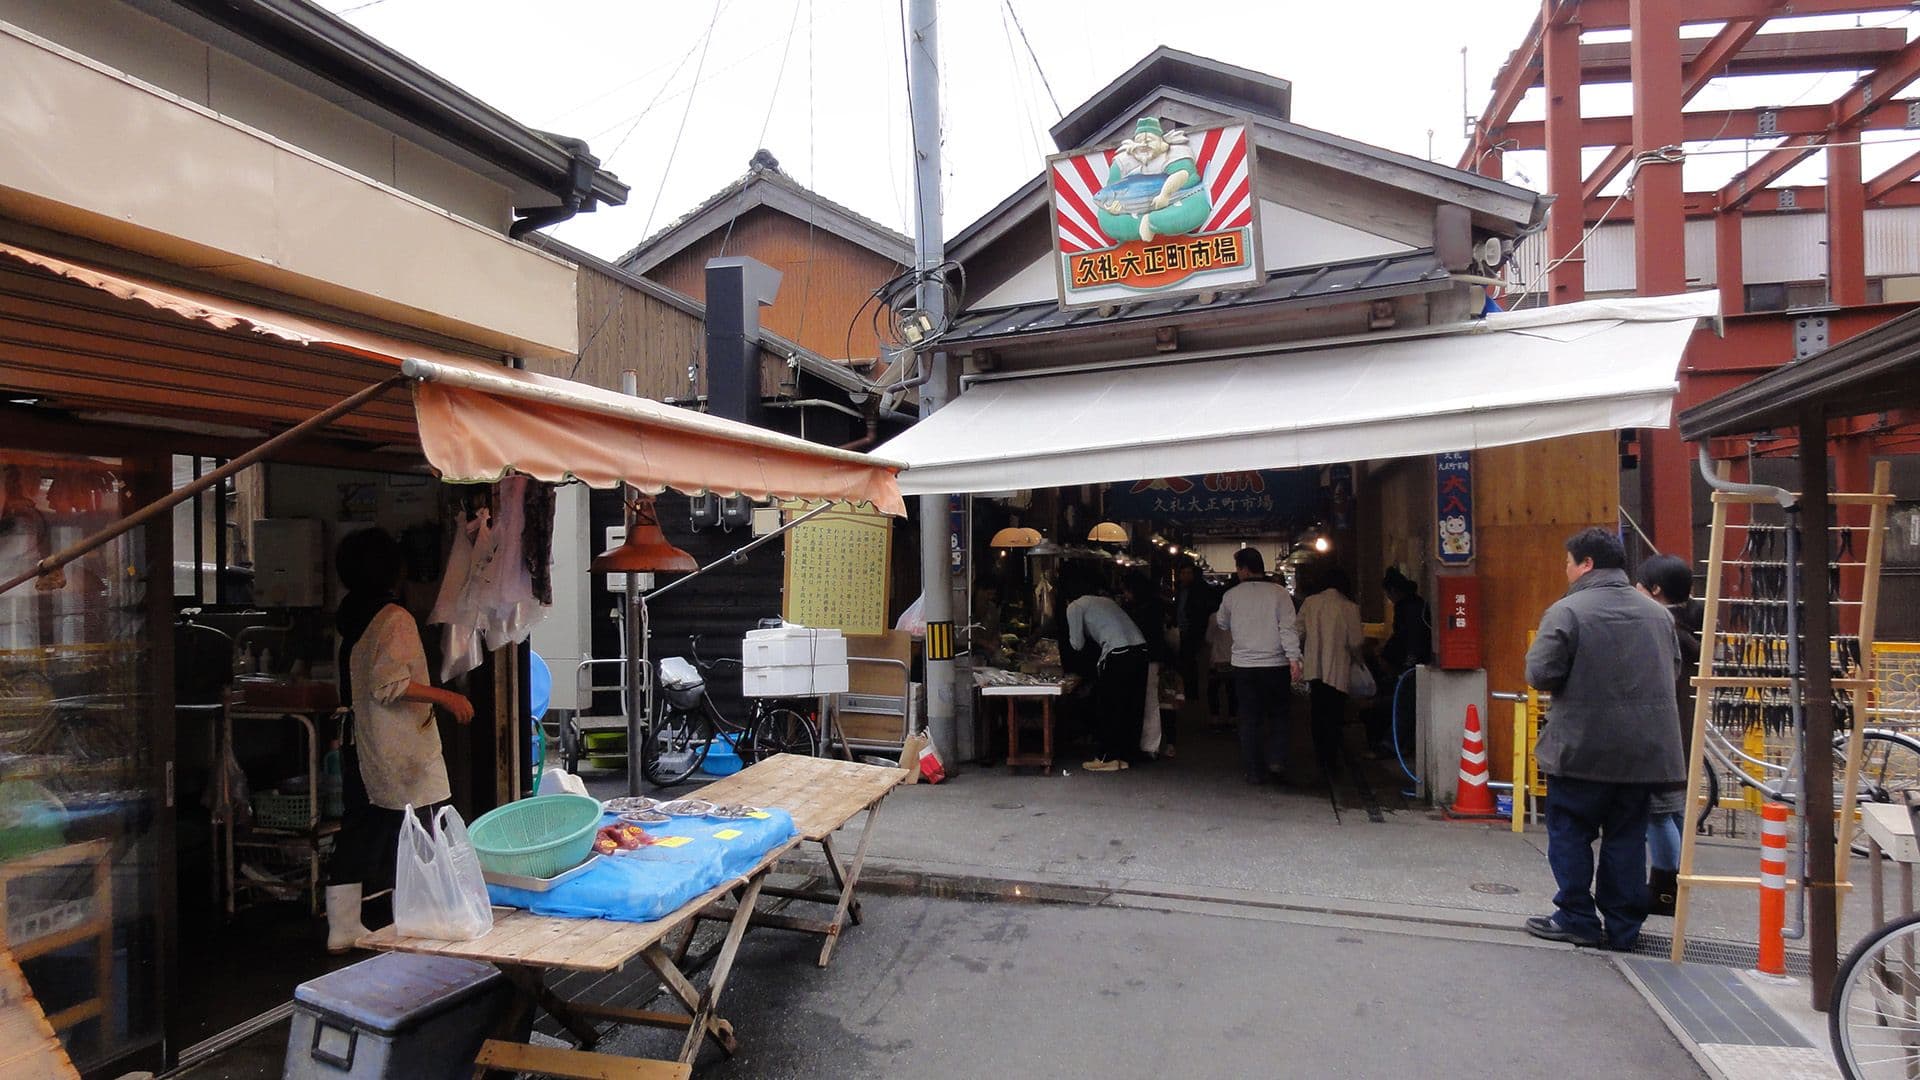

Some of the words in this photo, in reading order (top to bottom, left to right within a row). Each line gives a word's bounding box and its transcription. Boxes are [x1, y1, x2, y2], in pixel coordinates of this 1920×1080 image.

[1077, 236, 1237, 283] 久礼大正町市場
[1439, 462, 1469, 471] 大正町市場
[1153, 493, 1274, 513] 久礼大正町市場
[1443, 474, 1467, 512] 大入
[1456, 594, 1466, 628] 消火器
